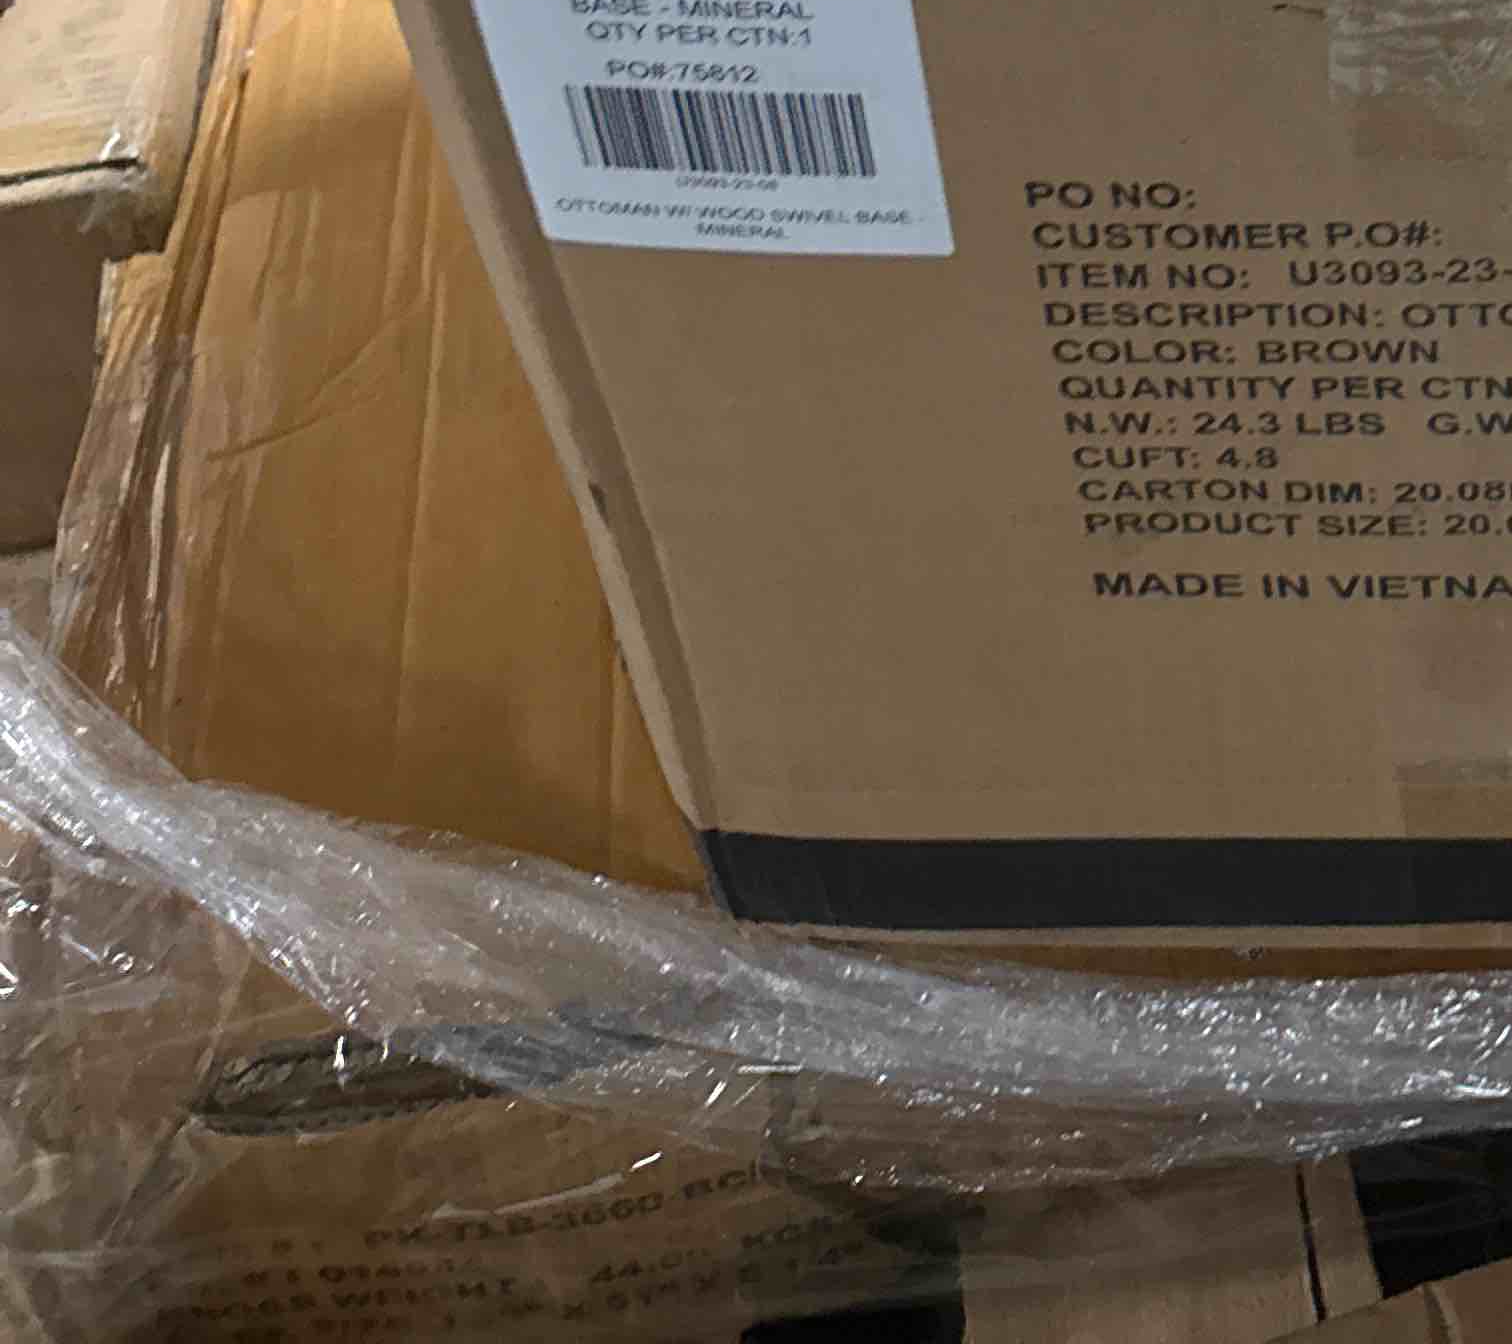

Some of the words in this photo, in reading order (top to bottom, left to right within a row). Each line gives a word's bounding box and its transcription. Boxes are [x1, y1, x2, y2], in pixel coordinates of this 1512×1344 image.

[677, 0, 815, 20] MINERAL
[585, 22, 648, 42] QTY
[656, 24, 718, 44] PER
[1025, 181, 1093, 209] PO
[1110, 181, 1196, 209] NO:
[554, 197, 660, 216] OTTOMAN
[698, 205, 766, 221] WOOD
[769, 208, 849, 224] SWIVEL
[855, 209, 912, 224] BASE
[694, 223, 790, 239] MINERAL
[1032, 222, 1309, 250] CUSTOMER
[1325, 222, 1442, 248] P.O#:
[1036, 263, 1149, 289] ITEM
[1168, 264, 1251, 289] NO:
[1045, 302, 1384, 329] DESCRIPTION:
[1052, 339, 1235, 365] COLOR:
[1258, 339, 1440, 365] BROWN
[1059, 376, 1293, 402] QUANTITY
[1312, 376, 1403, 400] PER
[1065, 412, 1176, 436] N.W.:
[1193, 411, 1279, 435] 24.3
[1298, 411, 1386, 437] LBS
[1072, 445, 1200, 471] CUFT:
[1215, 445, 1279, 470] 4.8
[1078, 479, 1268, 504] CARTON
[1285, 480, 1377, 504] DIM:
[1085, 512, 1298, 536] PRODUCT
[1317, 513, 1428, 535] SIZE:
[1094, 573, 1244, 597] MADE
[1262, 574, 1309, 597] IN
